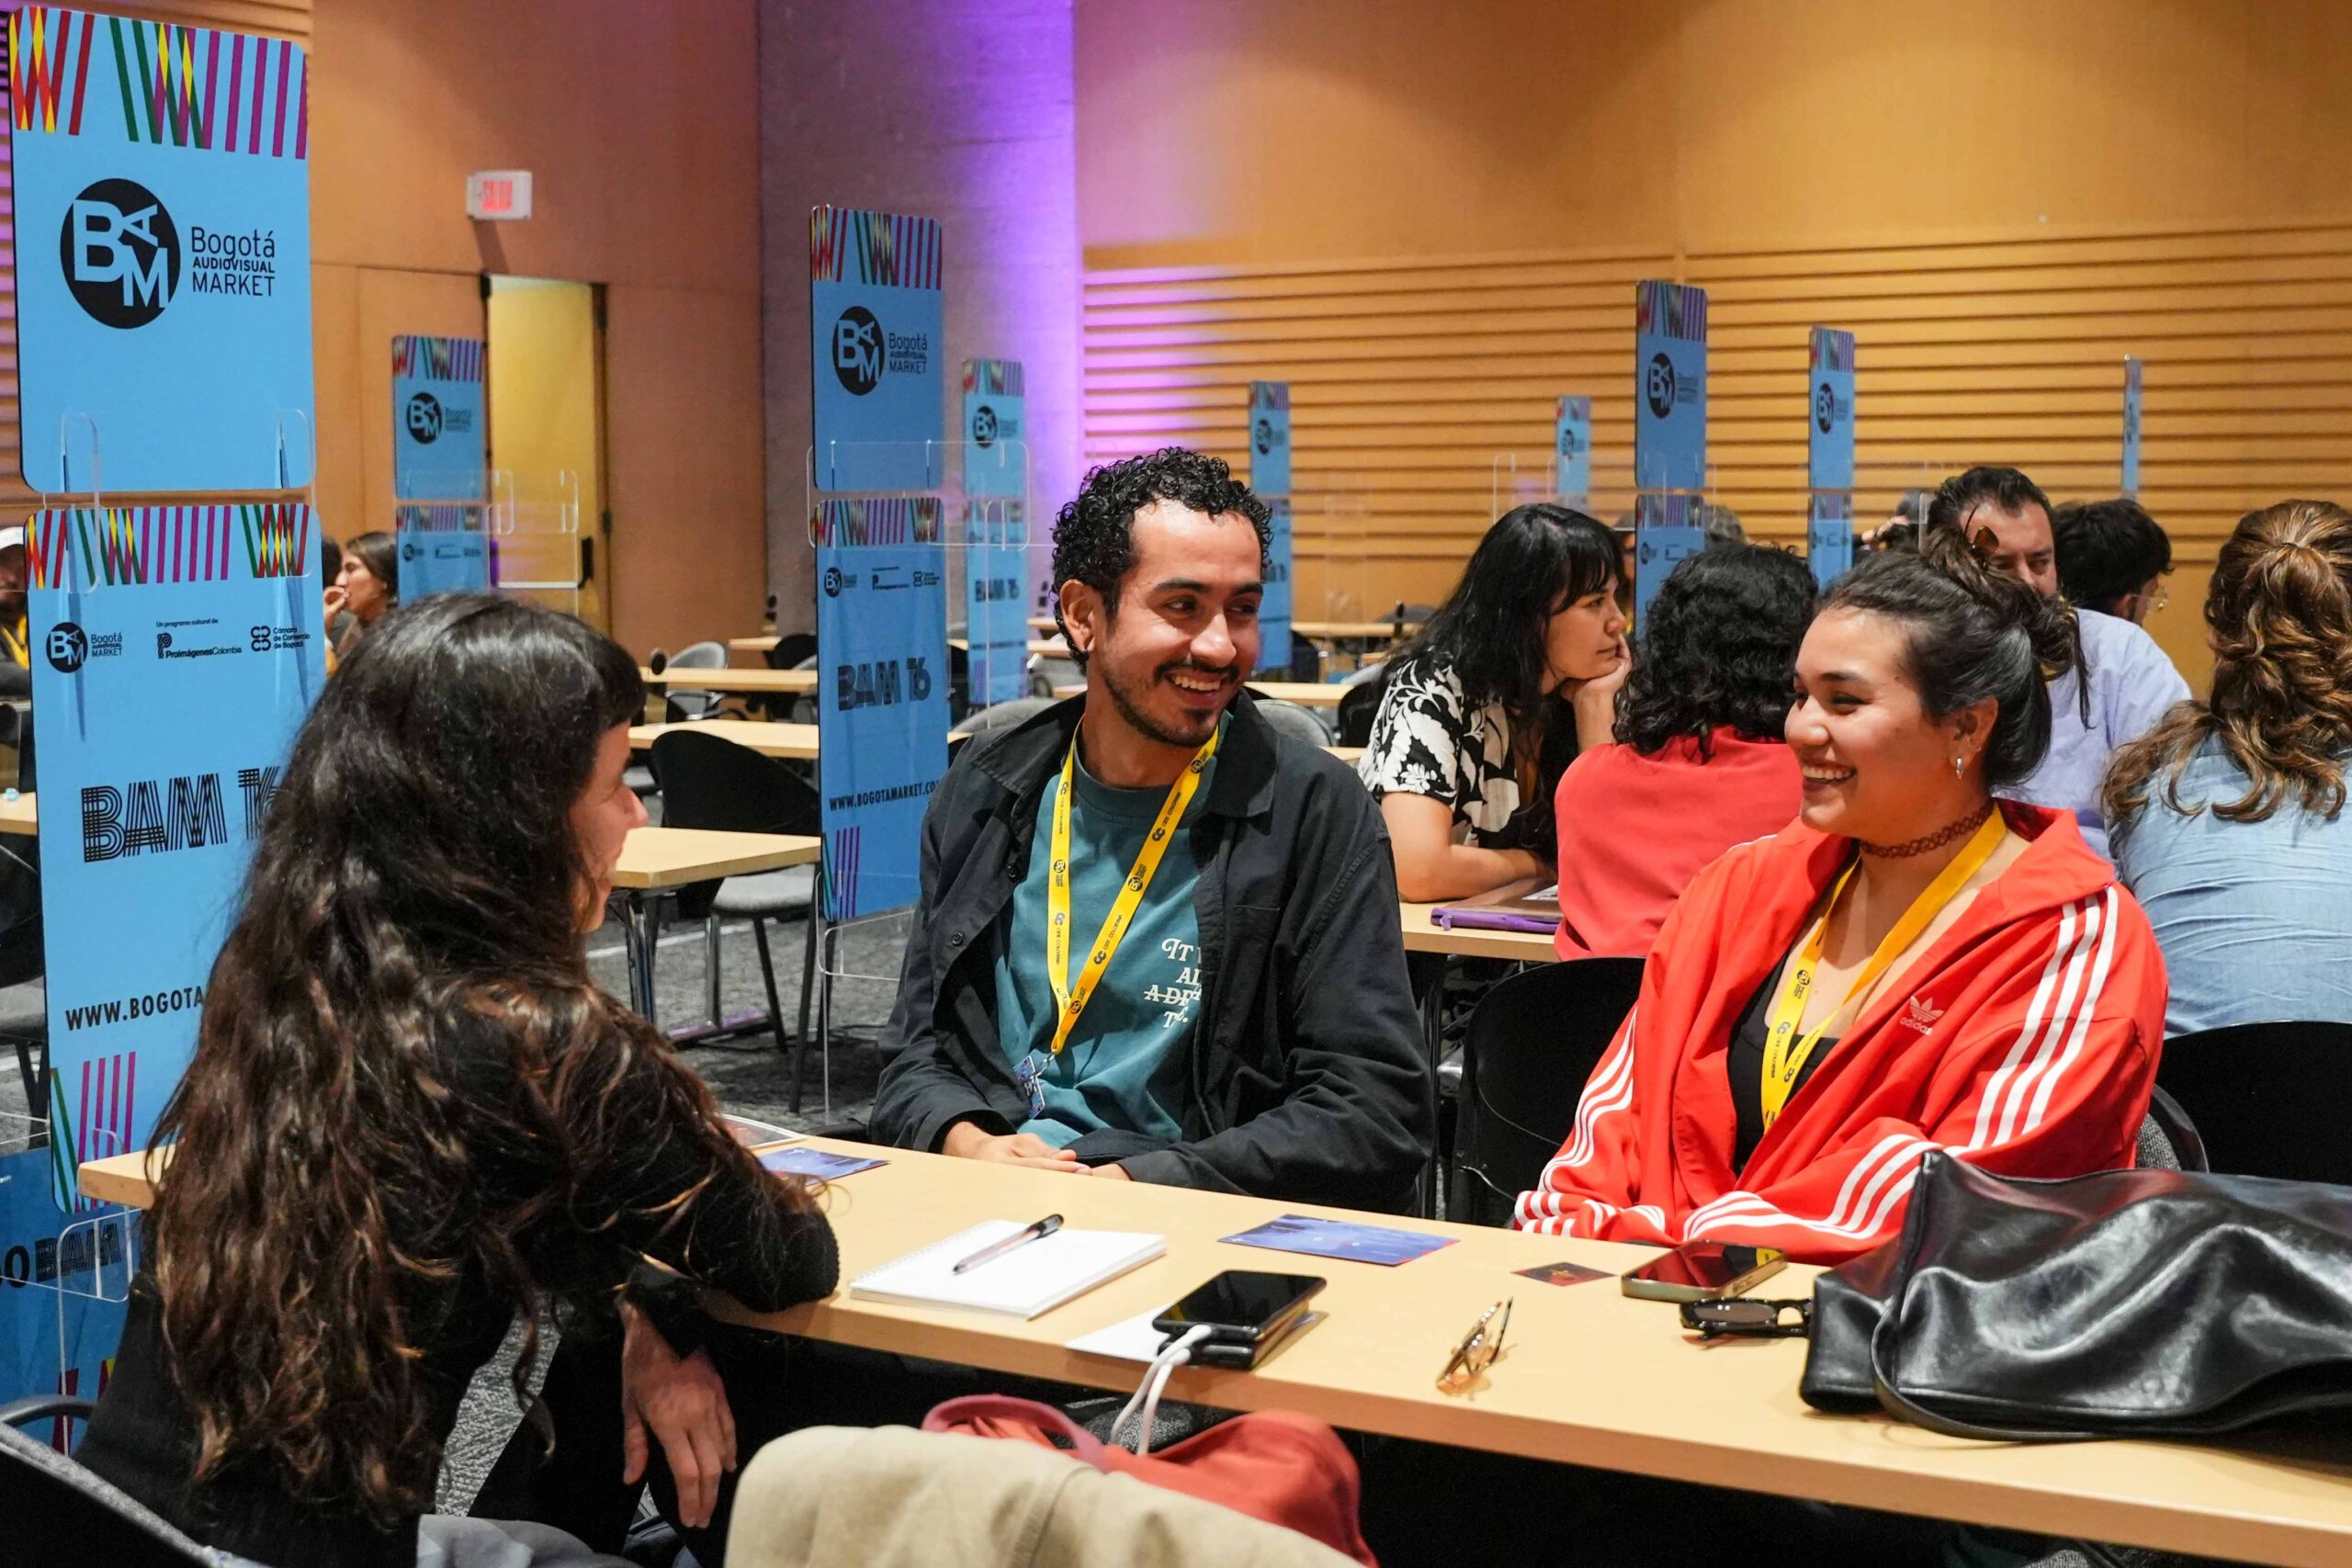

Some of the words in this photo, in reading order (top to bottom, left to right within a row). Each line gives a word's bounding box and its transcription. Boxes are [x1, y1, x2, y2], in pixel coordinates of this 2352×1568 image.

[73, 198, 169, 310] BAM
[190, 226, 275, 261] Bogotá
[192, 257, 275, 273] AUDIOVISUAL
[192, 271, 276, 296] MARKET
[837, 319, 880, 383] BAM
[888, 333, 928, 352] Bogotá
[889, 359, 927, 375] MARKET
[90, 632, 123, 645] Bogotá
[91, 648, 123, 658] MARKET
[837, 660, 902, 711] BAM
[906, 657, 932, 702] 16
[830, 781, 939, 811] WWW.BOGOTAMARKET.CO
[81, 773, 228, 863] BAM
[1161, 938, 1193, 962] IT
[65, 986, 205, 1031] WWW.BOGOTA
[1899, 1017, 1933, 1036] adidas
